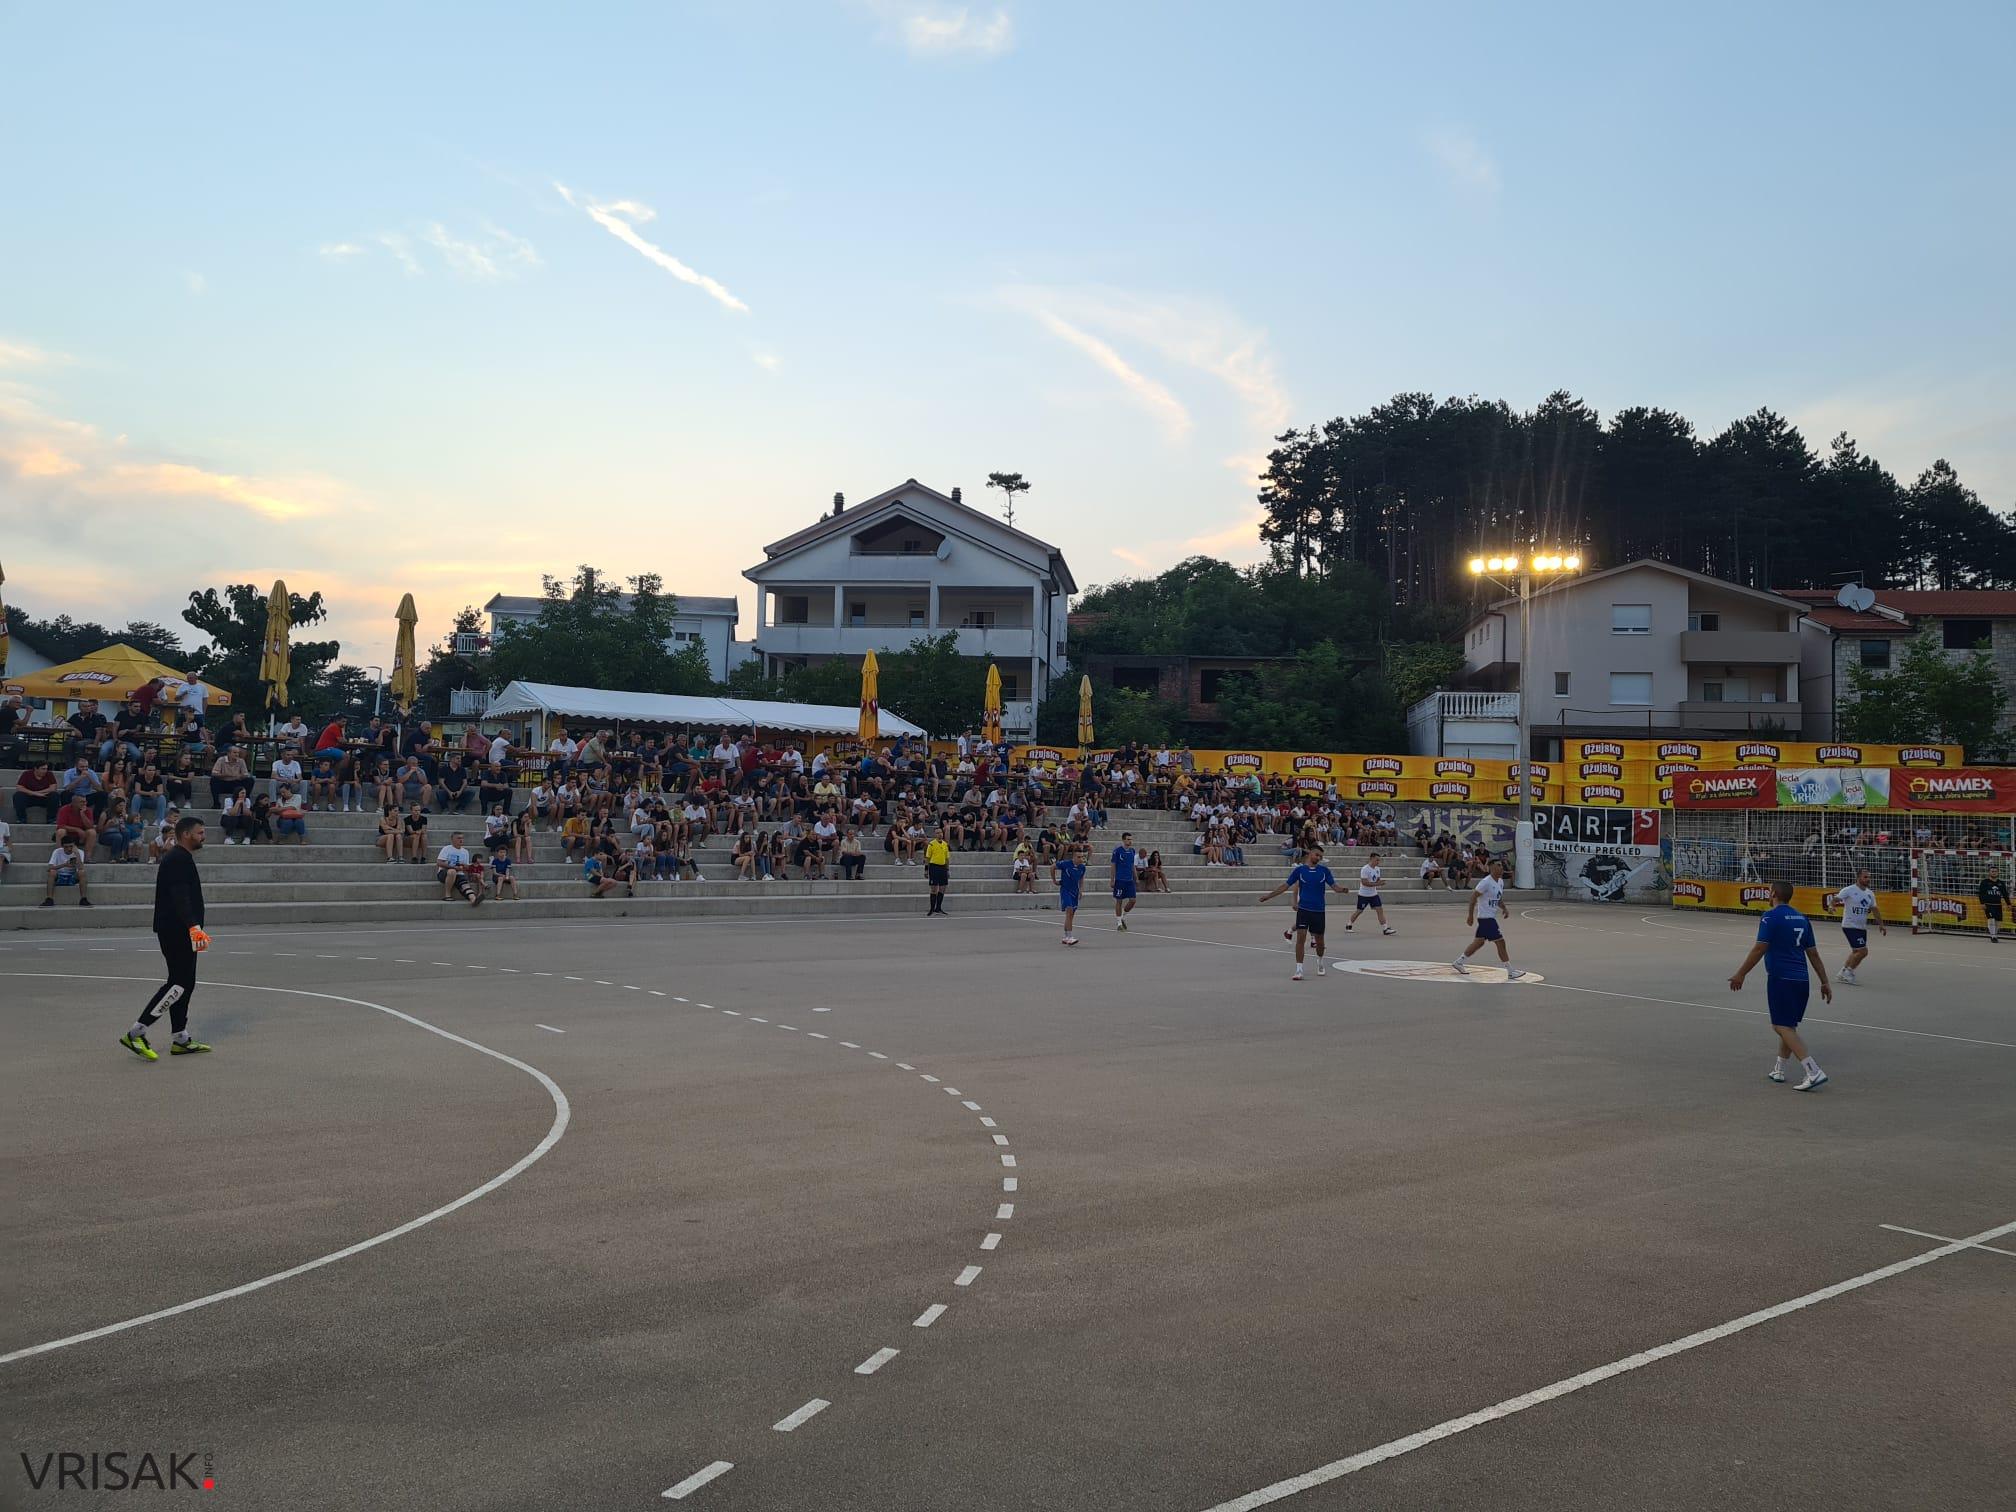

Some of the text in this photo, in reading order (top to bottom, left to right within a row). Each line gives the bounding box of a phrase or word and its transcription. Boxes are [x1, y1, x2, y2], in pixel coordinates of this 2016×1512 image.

[1584, 742, 1621, 755] Ožujsko
[1661, 743, 1698, 757] Ožujsko
[1739, 743, 1777, 757] Ožujsko
[1819, 745, 1859, 759] Ožujsko
[1901, 747, 1941, 761] Ožujsko
[1228, 753, 1260, 766] Ožujsko
[1296, 755, 1329, 768] Ožujsko
[1366, 757, 1400, 770] Ožujsko
[1437, 760, 1472, 773] Ožujsko
[1583, 762, 1619, 775] Ožujsko
[1361, 779, 1395, 793] Ožujsko
[1432, 781, 1467, 795] Ožujsko
[1584, 785, 1621, 798] Ožujsko
[1705, 777, 1757, 792] NAMEX
[1929, 777, 1993, 793] NAMEX
[1534, 808, 1654, 845] PARTS
[1542, 842, 1641, 856] TEHNIČKI PREGLED
[1793, 927, 1805, 946] 7
